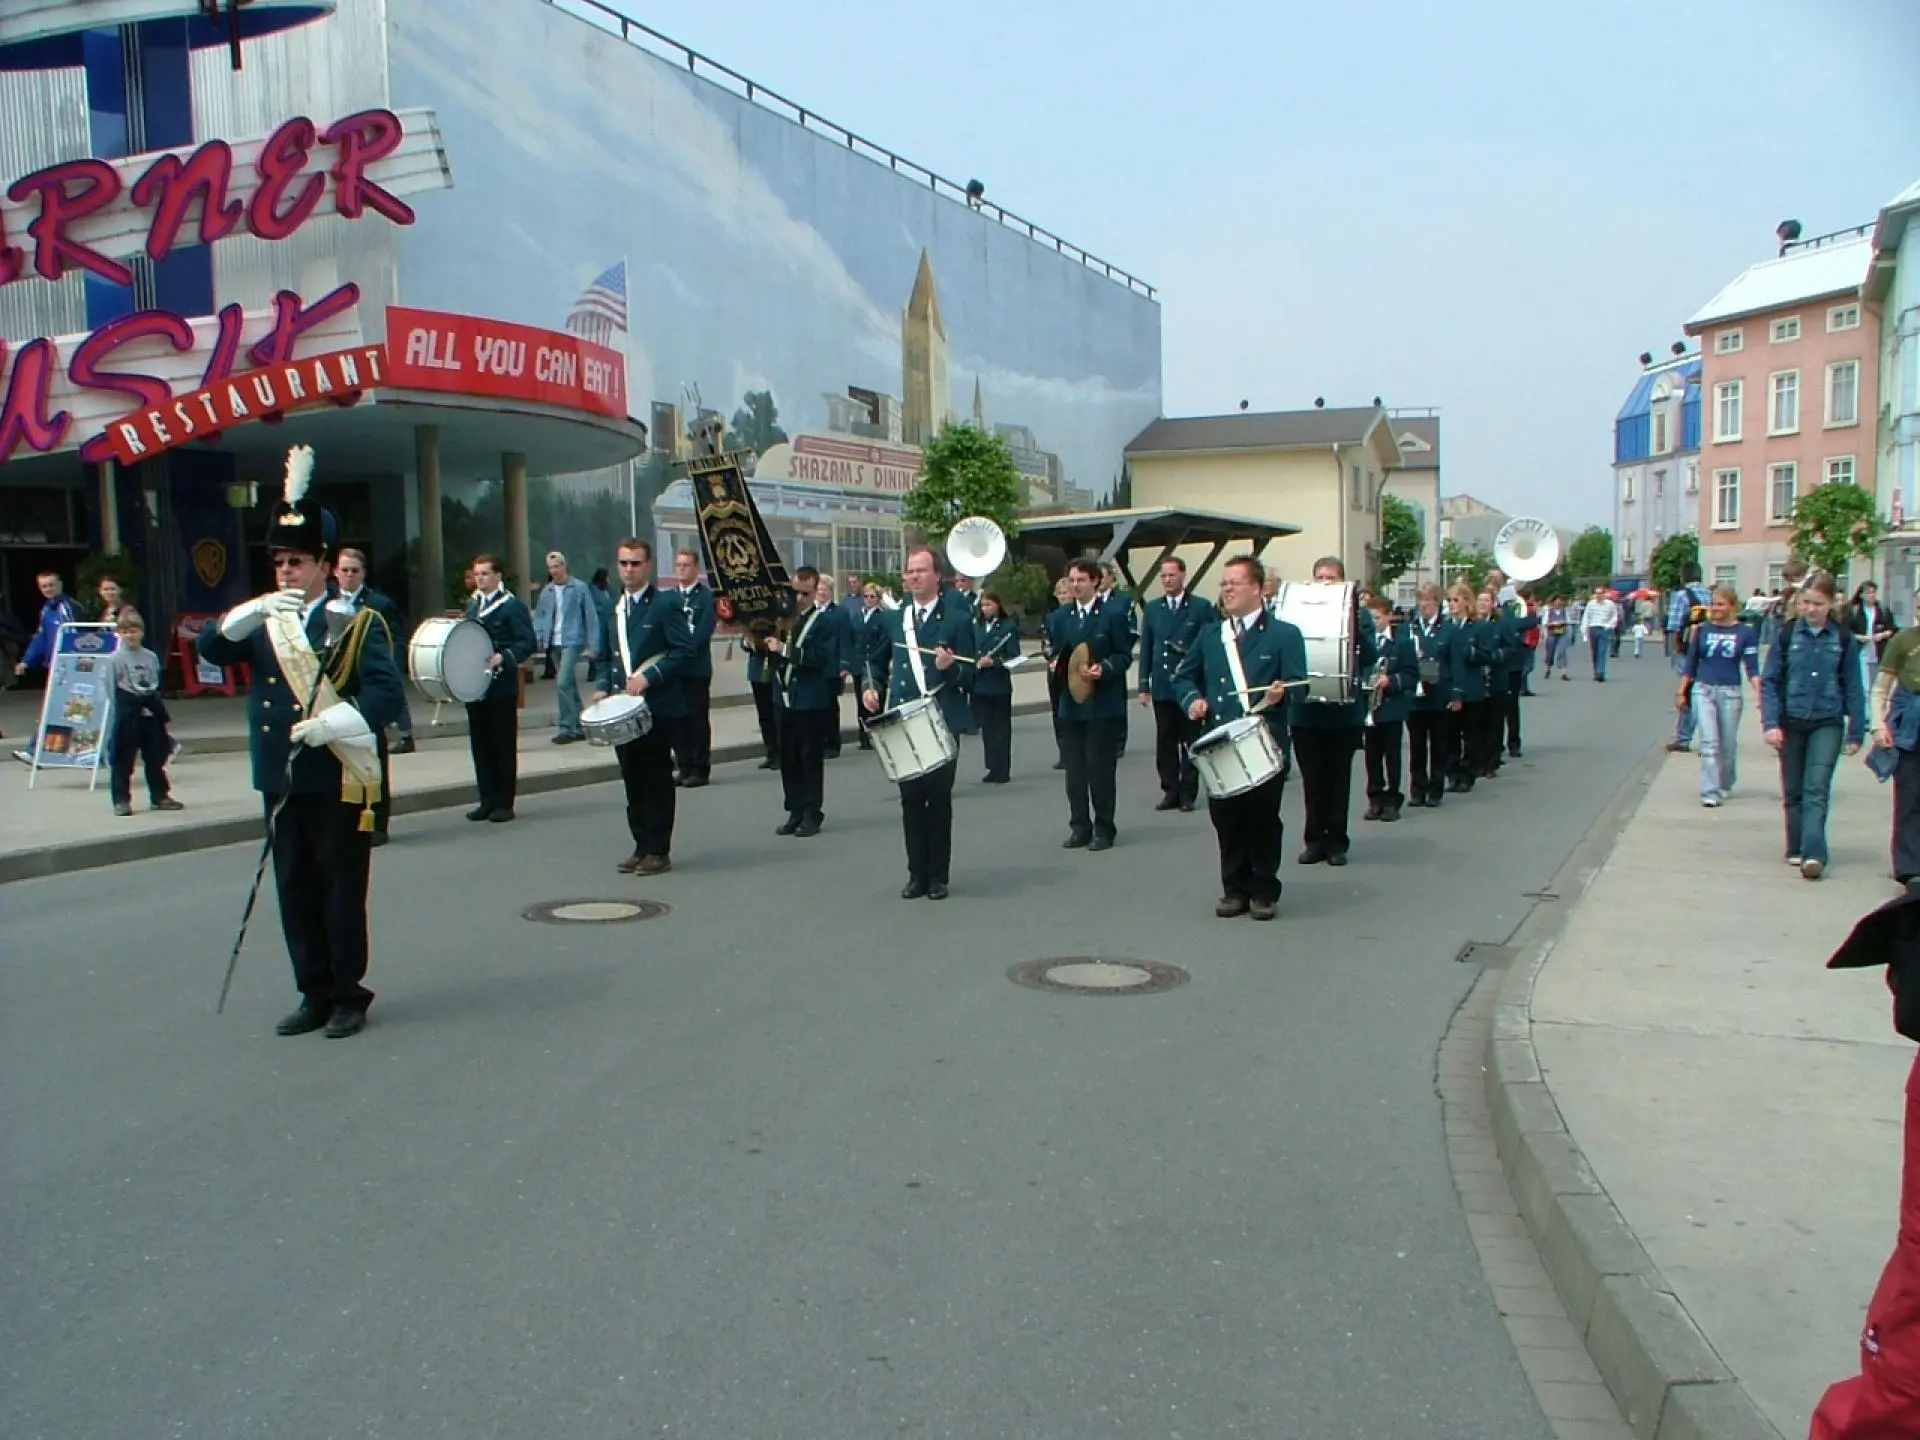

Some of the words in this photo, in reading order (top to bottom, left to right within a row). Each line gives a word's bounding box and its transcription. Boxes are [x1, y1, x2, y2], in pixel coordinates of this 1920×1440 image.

[405, 328, 461, 370] ALL
[474, 335, 526, 377] YOU
[535, 346, 577, 388] CAN
[119, 350, 382, 455] RESTAURANT
[1706, 638, 1735, 657] 73
